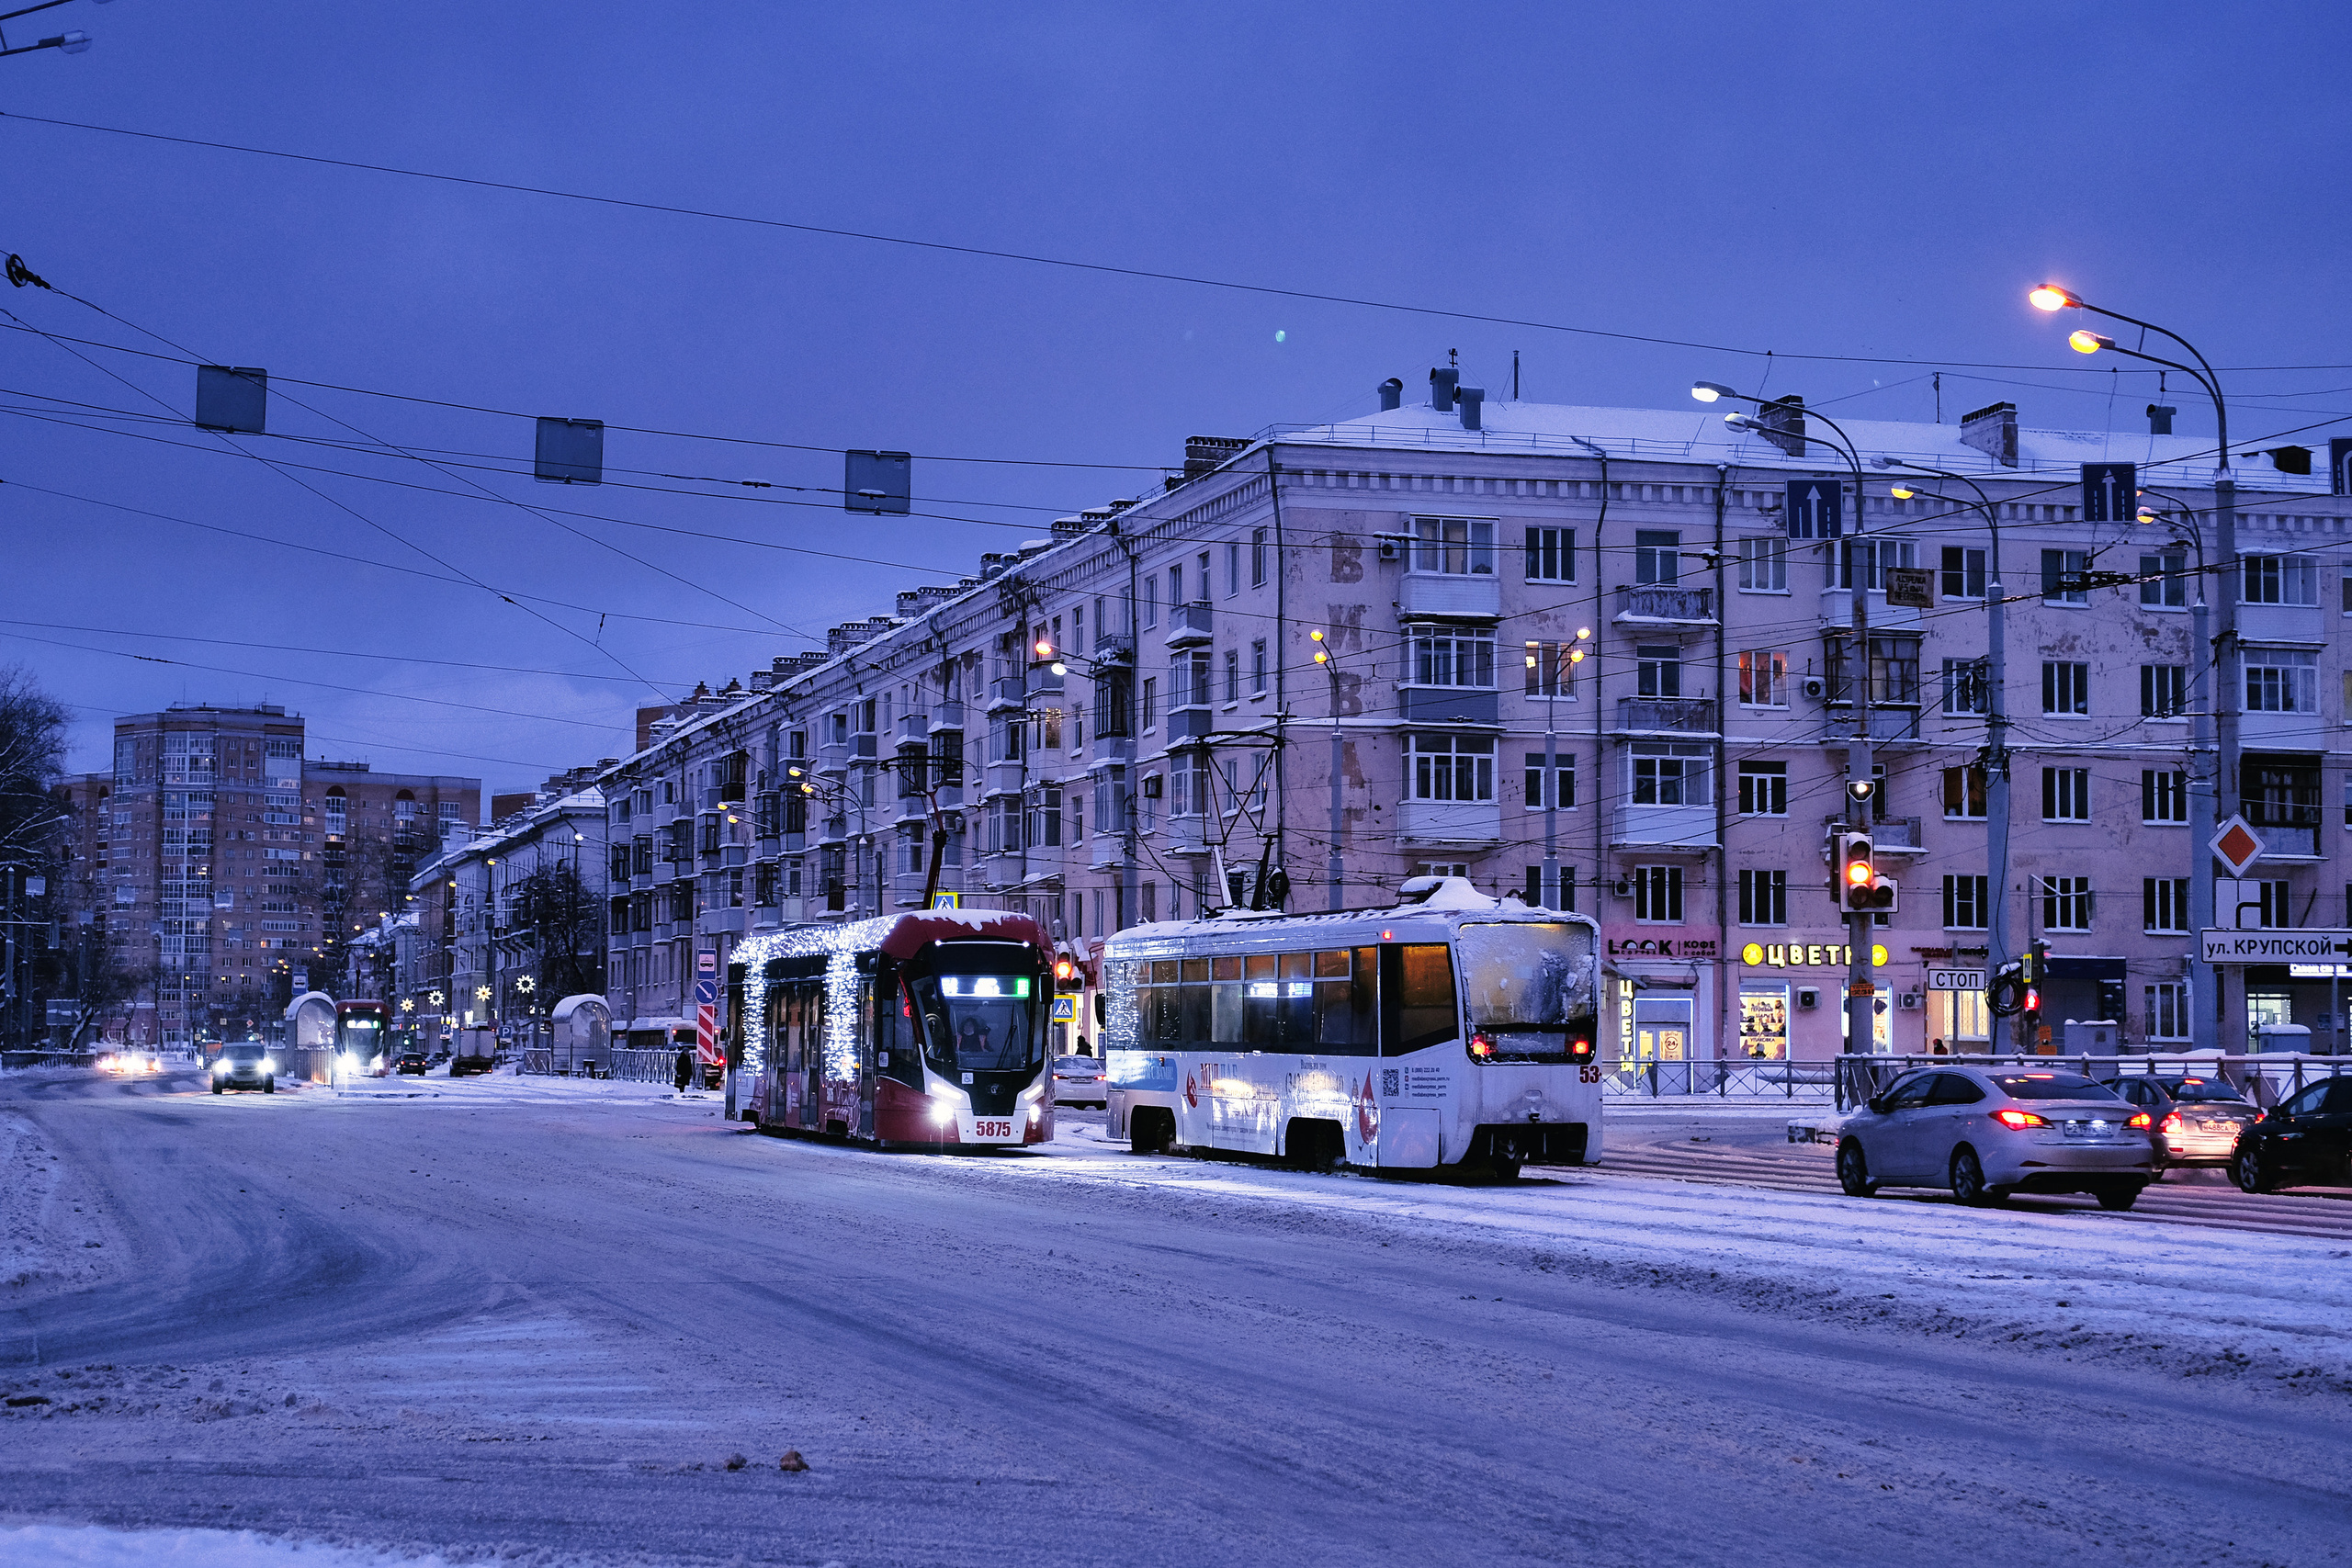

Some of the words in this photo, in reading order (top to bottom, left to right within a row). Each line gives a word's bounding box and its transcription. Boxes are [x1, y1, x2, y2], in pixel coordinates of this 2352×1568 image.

[1608, 939, 1673, 955] LOOK
[1684, 941, 1716, 949] КОФЕ
[2207, 942, 2231, 958] ул.
[2234, 935, 2332, 956] КРУПСКОЙ
[1936, 973, 1978, 987] СТОП
[976, 1121, 1012, 1137] 5875
